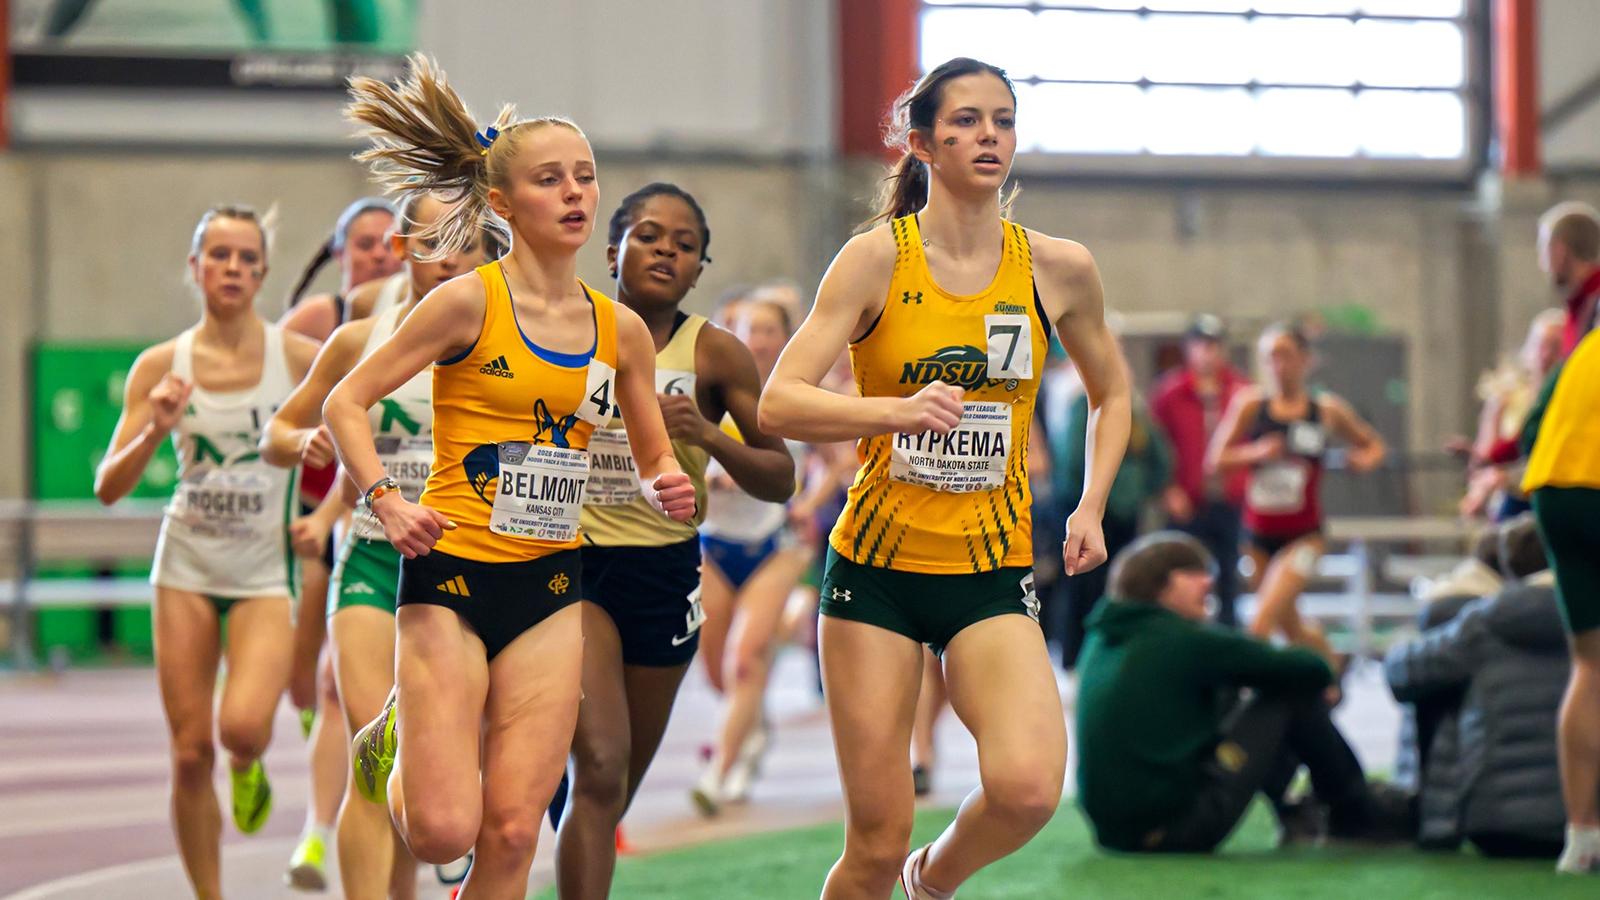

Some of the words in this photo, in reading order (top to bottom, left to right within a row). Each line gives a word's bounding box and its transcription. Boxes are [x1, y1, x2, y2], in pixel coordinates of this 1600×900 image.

[994, 303, 1026, 313] SUMMIT
[988, 325, 1022, 371] 7
[480, 366, 514, 379] adidas
[899, 361, 986, 385] NDSU
[590, 379, 610, 416] 4
[976, 405, 997, 413] LEAGUE
[897, 430, 1006, 457] RYPKEMA
[909, 456, 935, 467] NORTH
[936, 460, 965, 470] DAKOTA
[967, 461, 989, 470] STATE
[918, 473, 946, 481] UNIVERSITY
[501, 471, 585, 504] BELMONT
[187, 491, 264, 514] ROGERS
[526, 504, 552, 515] KANSAS
[553, 507, 565, 516] CITY
[519, 519, 543, 527] UNIVERSITY
